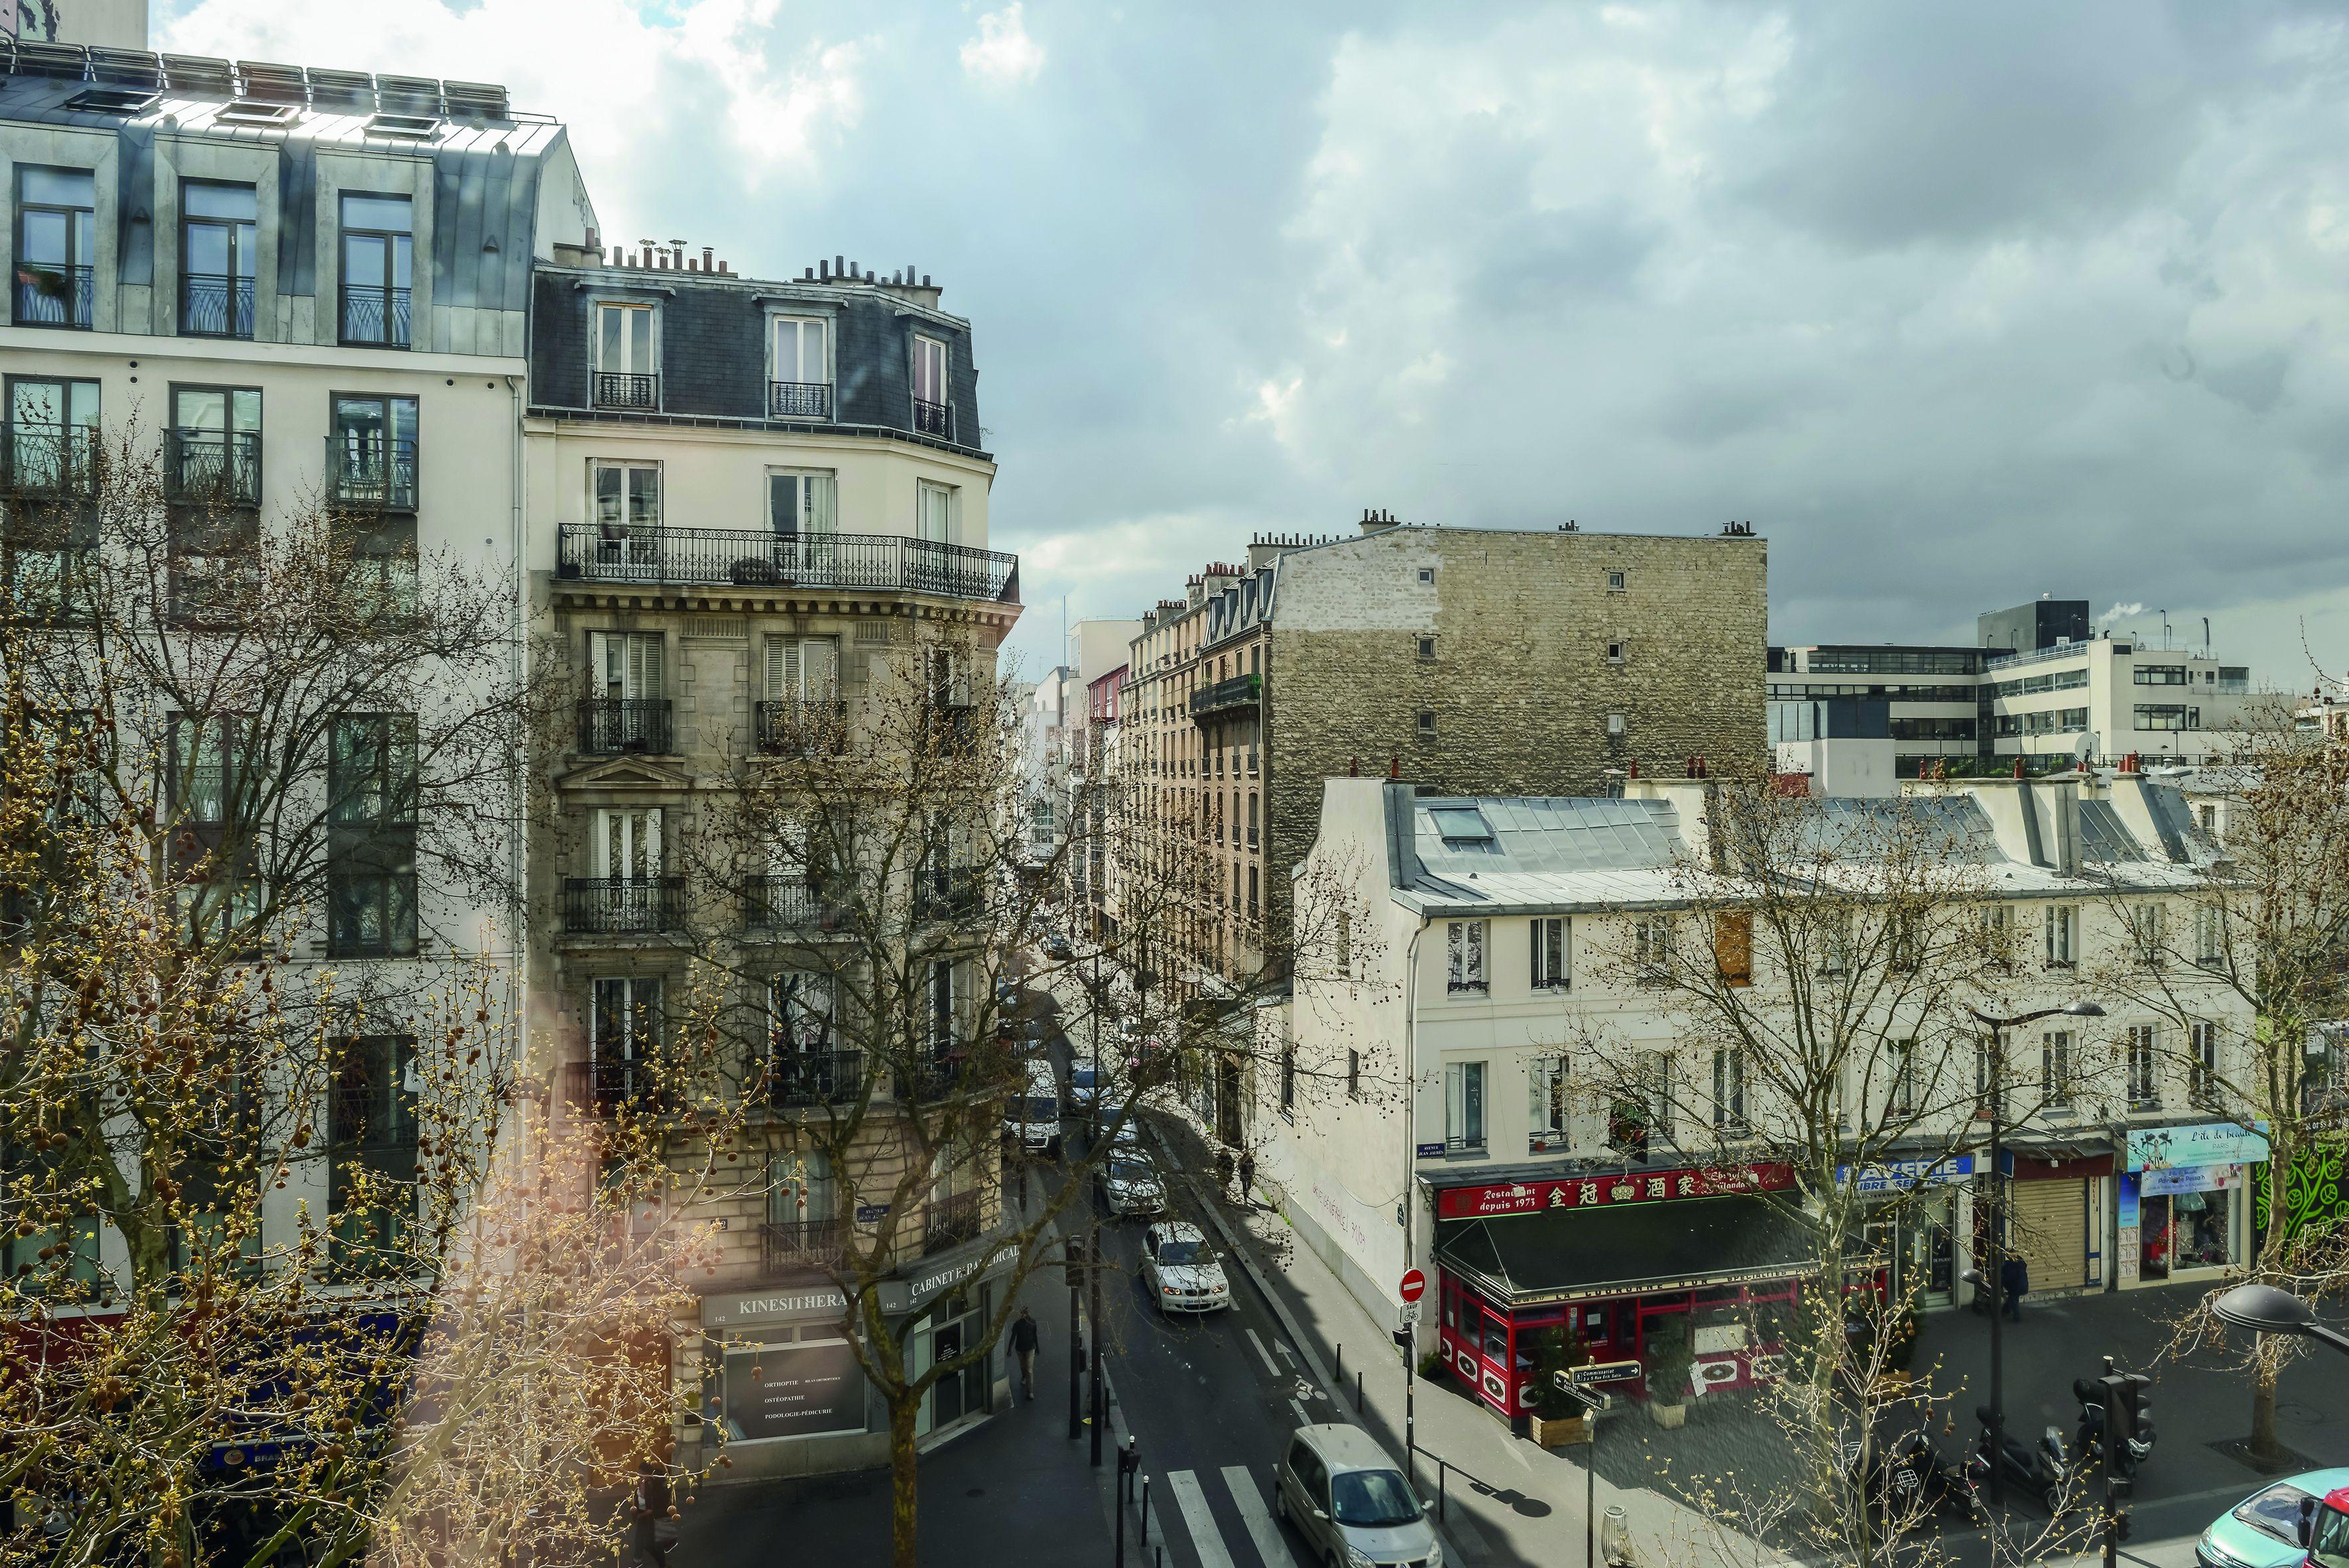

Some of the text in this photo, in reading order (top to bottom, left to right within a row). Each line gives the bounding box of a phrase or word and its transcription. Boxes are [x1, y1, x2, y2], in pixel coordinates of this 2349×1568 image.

[1856, 1177, 1948, 1190] IBRE SERICE
[1484, 1188, 1536, 1200] Restant
[1480, 1197, 1536, 1212] depuis 1973
[912, 1244, 1020, 1296] CABINET PARADICAL
[739, 1293, 862, 1314] KINESITHERA
[764, 1380, 799, 1388] ORTHOPTIE
[764, 1395, 805, 1404] OSTÉOPATHIE
[1563, 1384, 1597, 1405] BUTTES-CHAUMONT
[765, 1408, 833, 1419] PODOLOGIE-PÉDICURIE
[255, 1451, 308, 1463] BRASE
